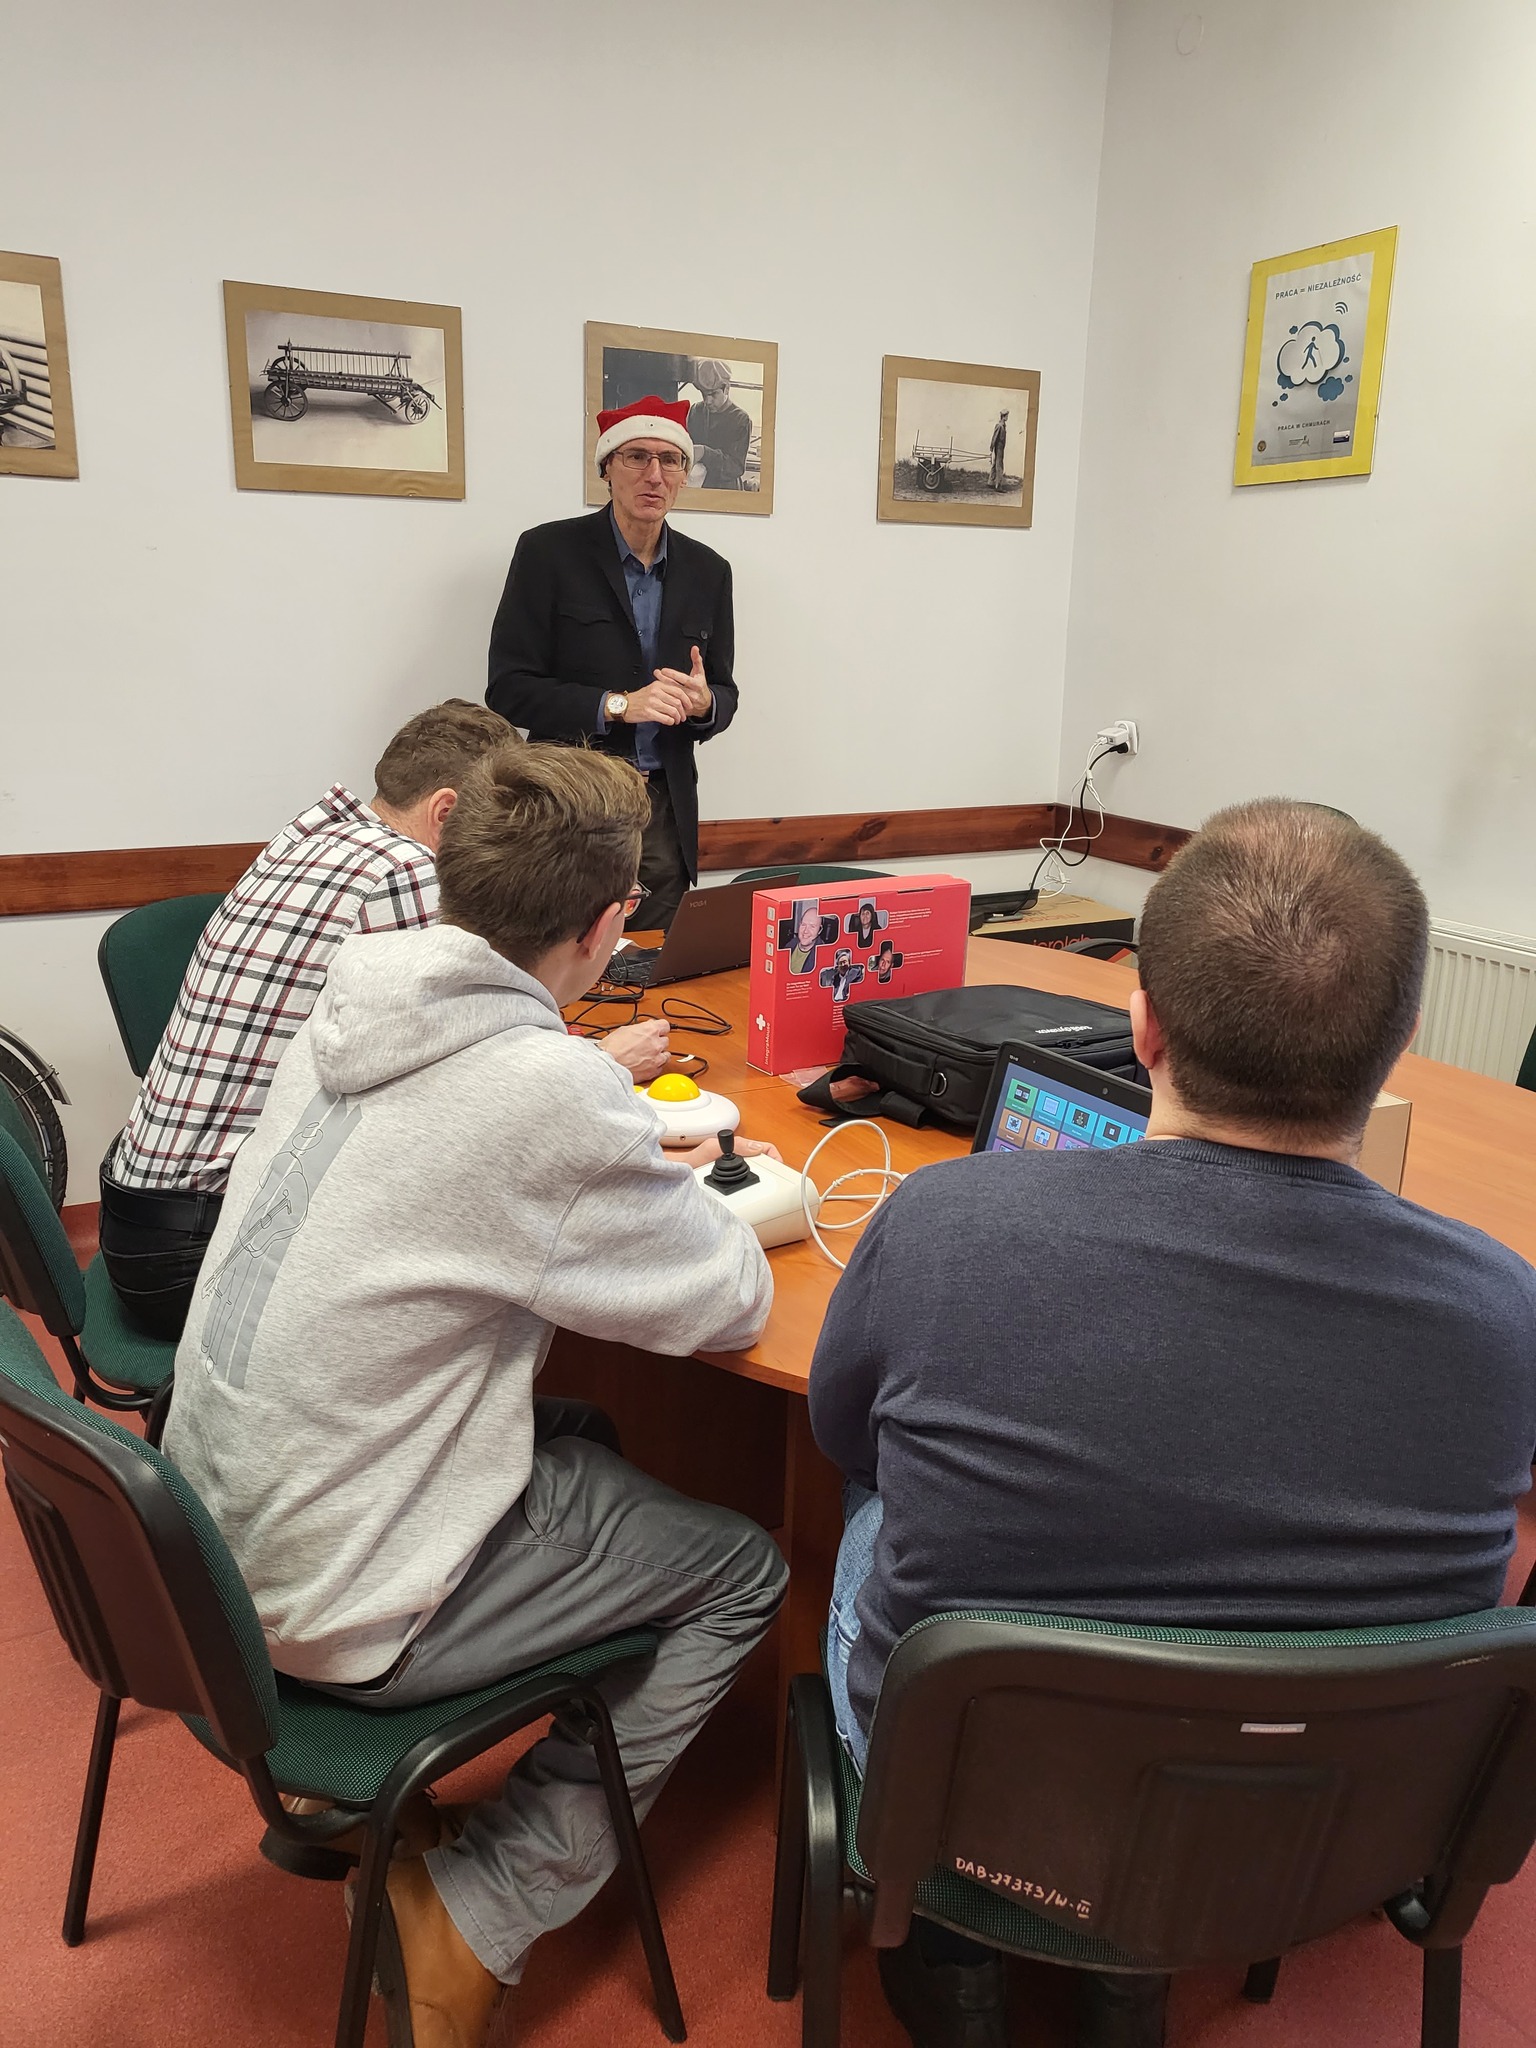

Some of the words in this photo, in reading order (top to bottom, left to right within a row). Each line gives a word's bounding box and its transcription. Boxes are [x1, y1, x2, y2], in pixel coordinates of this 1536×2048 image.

[1275, 287, 1299, 300] PRACA
[1307, 273, 1362, 293] NIEZALEŻNOŚĆ
[1277, 423, 1295, 431] PRACA
